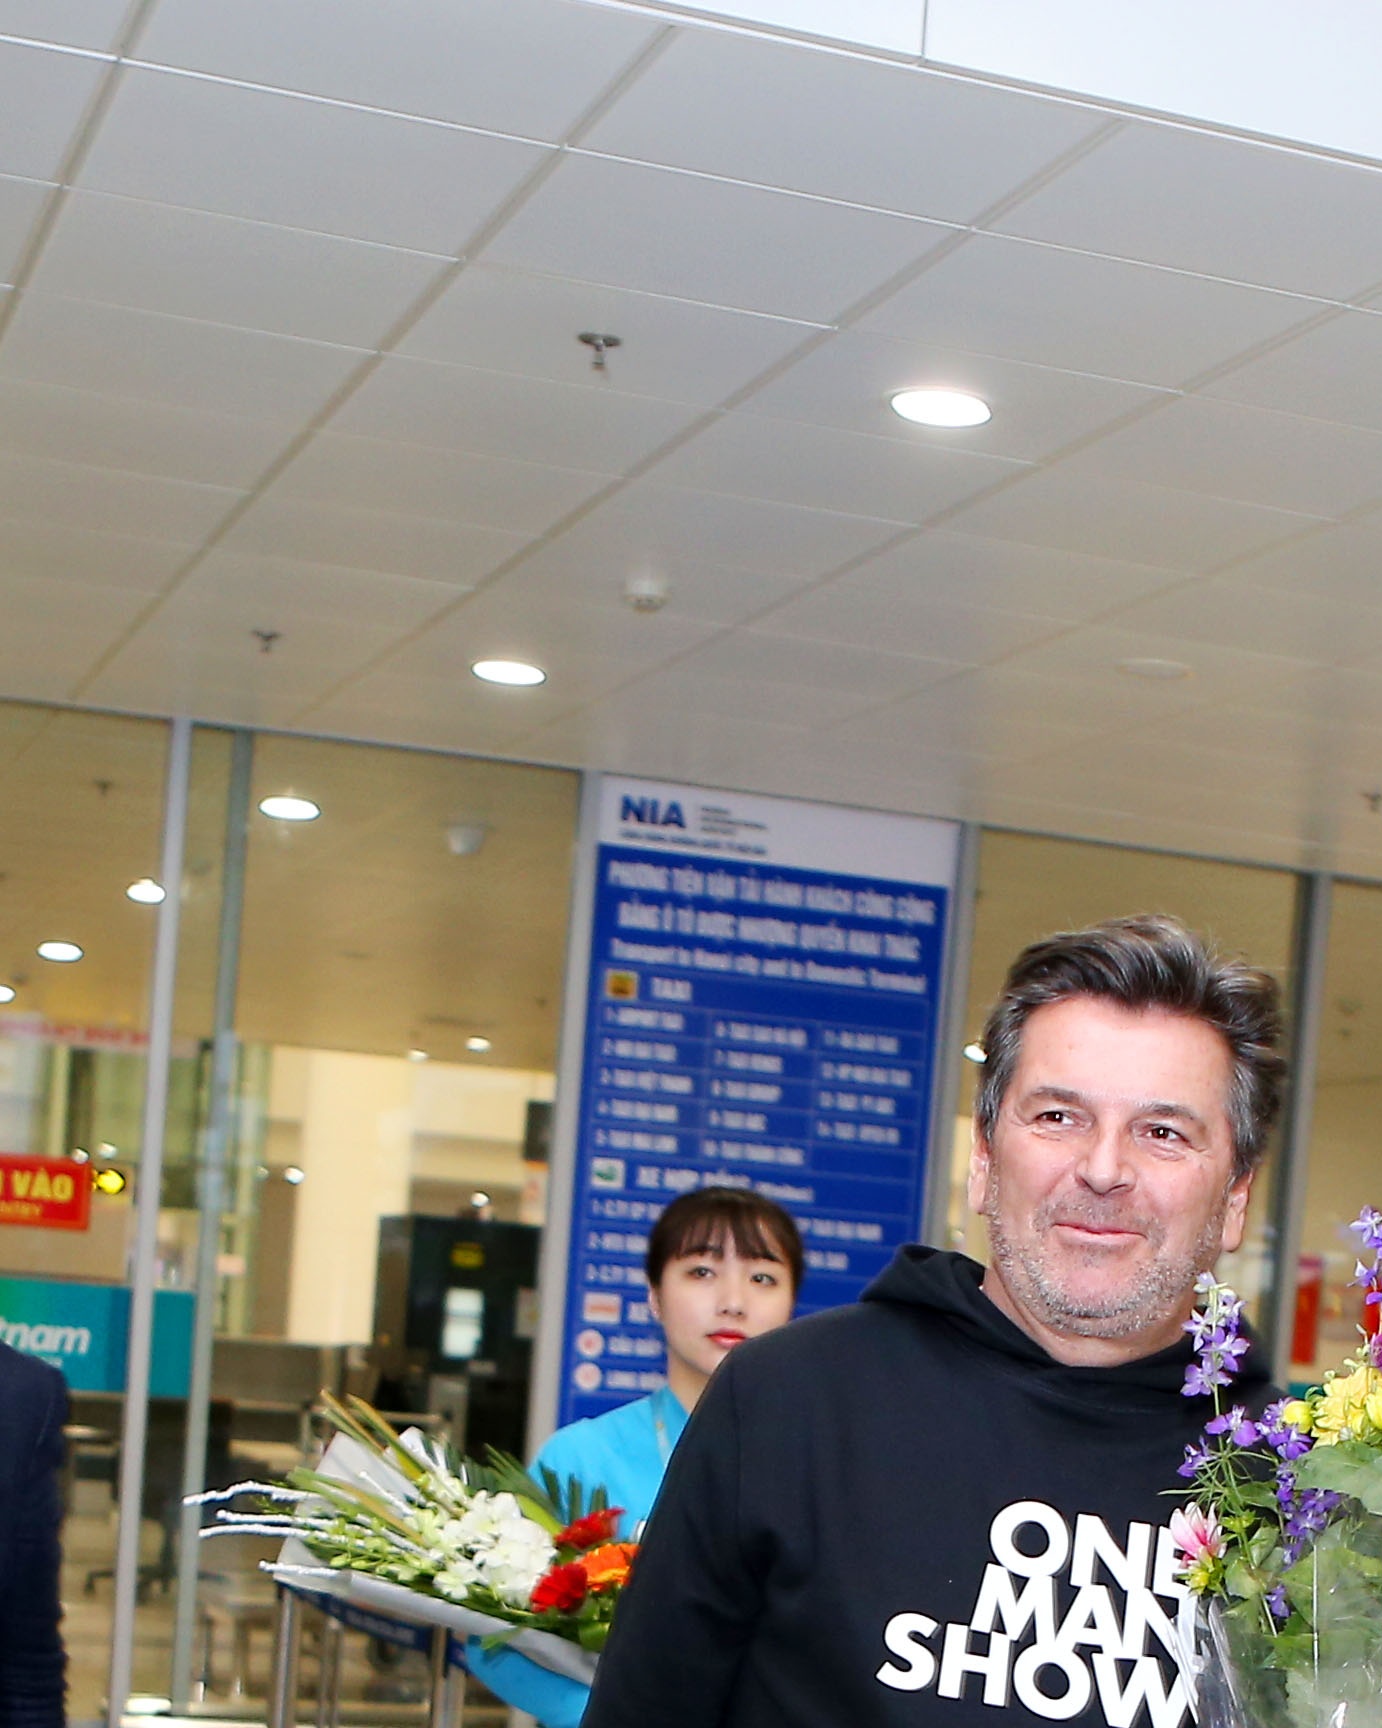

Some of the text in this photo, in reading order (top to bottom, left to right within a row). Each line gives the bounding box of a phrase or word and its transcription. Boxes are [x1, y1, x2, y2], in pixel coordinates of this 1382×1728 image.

[620, 794, 687, 829] NIA
[989, 1500, 1190, 1600] ONE
[969, 1562, 1199, 1662] MAN
